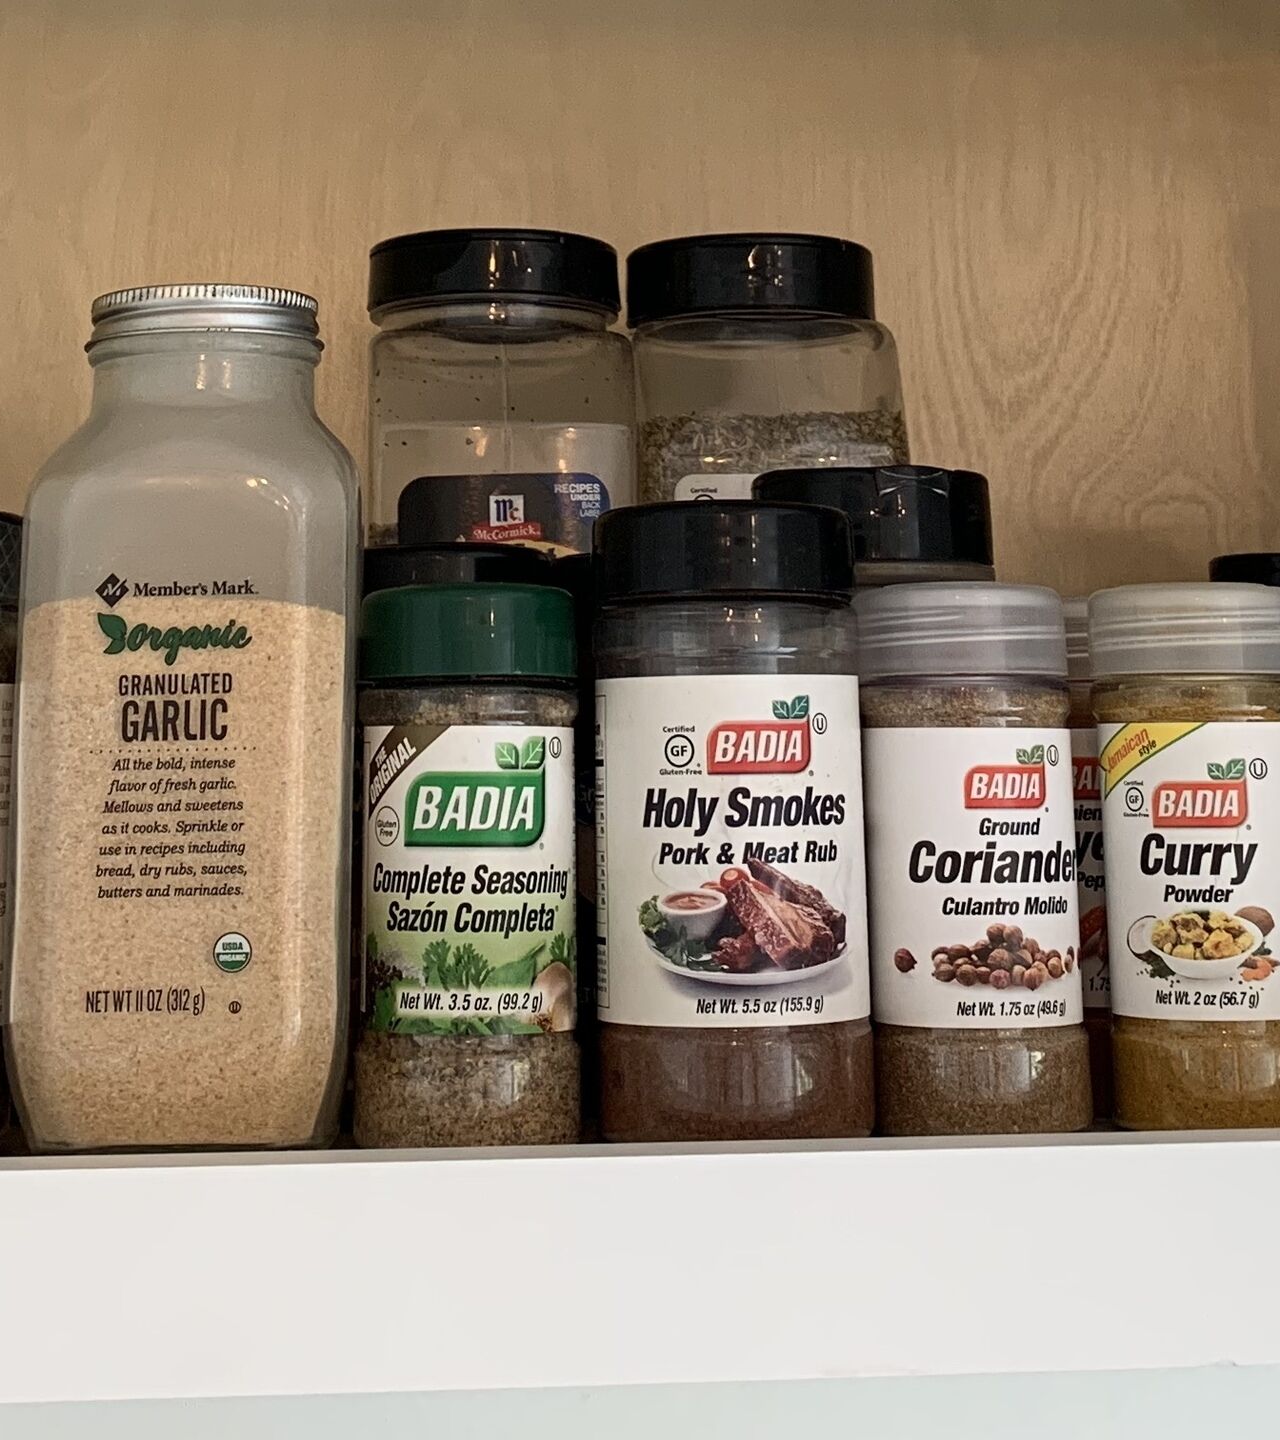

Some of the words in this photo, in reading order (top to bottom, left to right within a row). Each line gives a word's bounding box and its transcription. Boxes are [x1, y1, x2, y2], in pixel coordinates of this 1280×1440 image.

[555, 484, 600, 493] RECIPES
[474, 528, 538, 540] McCormick
[133, 582, 207, 597] Member's
[212, 580, 255, 595] Mark
[127, 619, 252, 666] organic
[119, 673, 232, 696] GRANULATED
[121, 698, 228, 742] GARLIC
[671, 746, 687, 756] GF
[715, 730, 803, 763] BADIA
[1138, 740, 1157, 757] style
[112, 759, 130, 771] All
[133, 760, 152, 770] the
[156, 758, 186, 771] bold,
[190, 758, 235, 769] intense
[370, 737, 416, 804] ORIGINAL
[108, 780, 146, 795] flavor
[150, 779, 162, 794] of
[163, 778, 196, 793] fresh
[200, 777, 237, 793] garlic.
[971, 773, 1041, 799] BADIA
[103, 802, 153, 813] Mellows
[157, 800, 181, 811] and
[185, 800, 243, 811] sweetens
[413, 786, 536, 831] BADIA
[643, 788, 719, 837] Holy
[725, 787, 845, 827] Smokes
[1158, 790, 1240, 818] BADIA
[102, 824, 117, 834] as
[121, 822, 129, 833] it
[133, 822, 171, 833] cooks.
[176, 821, 227, 835] Sprinkle
[231, 822, 244, 831] or
[979, 818, 1040, 836] Ground
[99, 845, 121, 855] use
[125, 843, 136, 854] in
[140, 842, 184, 857] recipes
[188, 841, 245, 855] including
[659, 843, 710, 864] Pork
[716, 843, 735, 864] &
[742, 842, 799, 864] Meat
[805, 840, 837, 862] Rub
[1140, 833, 1258, 885] Curry
[96, 865, 135, 877] bread,
[140, 864, 161, 879] dry
[165, 864, 196, 876] rubs,
[201, 865, 247, 876] sauces,
[373, 863, 465, 899] Complete
[471, 864, 568, 899] Seasoning
[98, 886, 142, 898] butters
[146, 885, 170, 897] and
[174, 884, 244, 896] marinades.
[1164, 885, 1233, 903] Powder
[942, 897, 1019, 915] Culantro
[1024, 896, 1067, 915] Molido
[387, 901, 448, 932] Sazón
[454, 902, 555, 939] Completa
